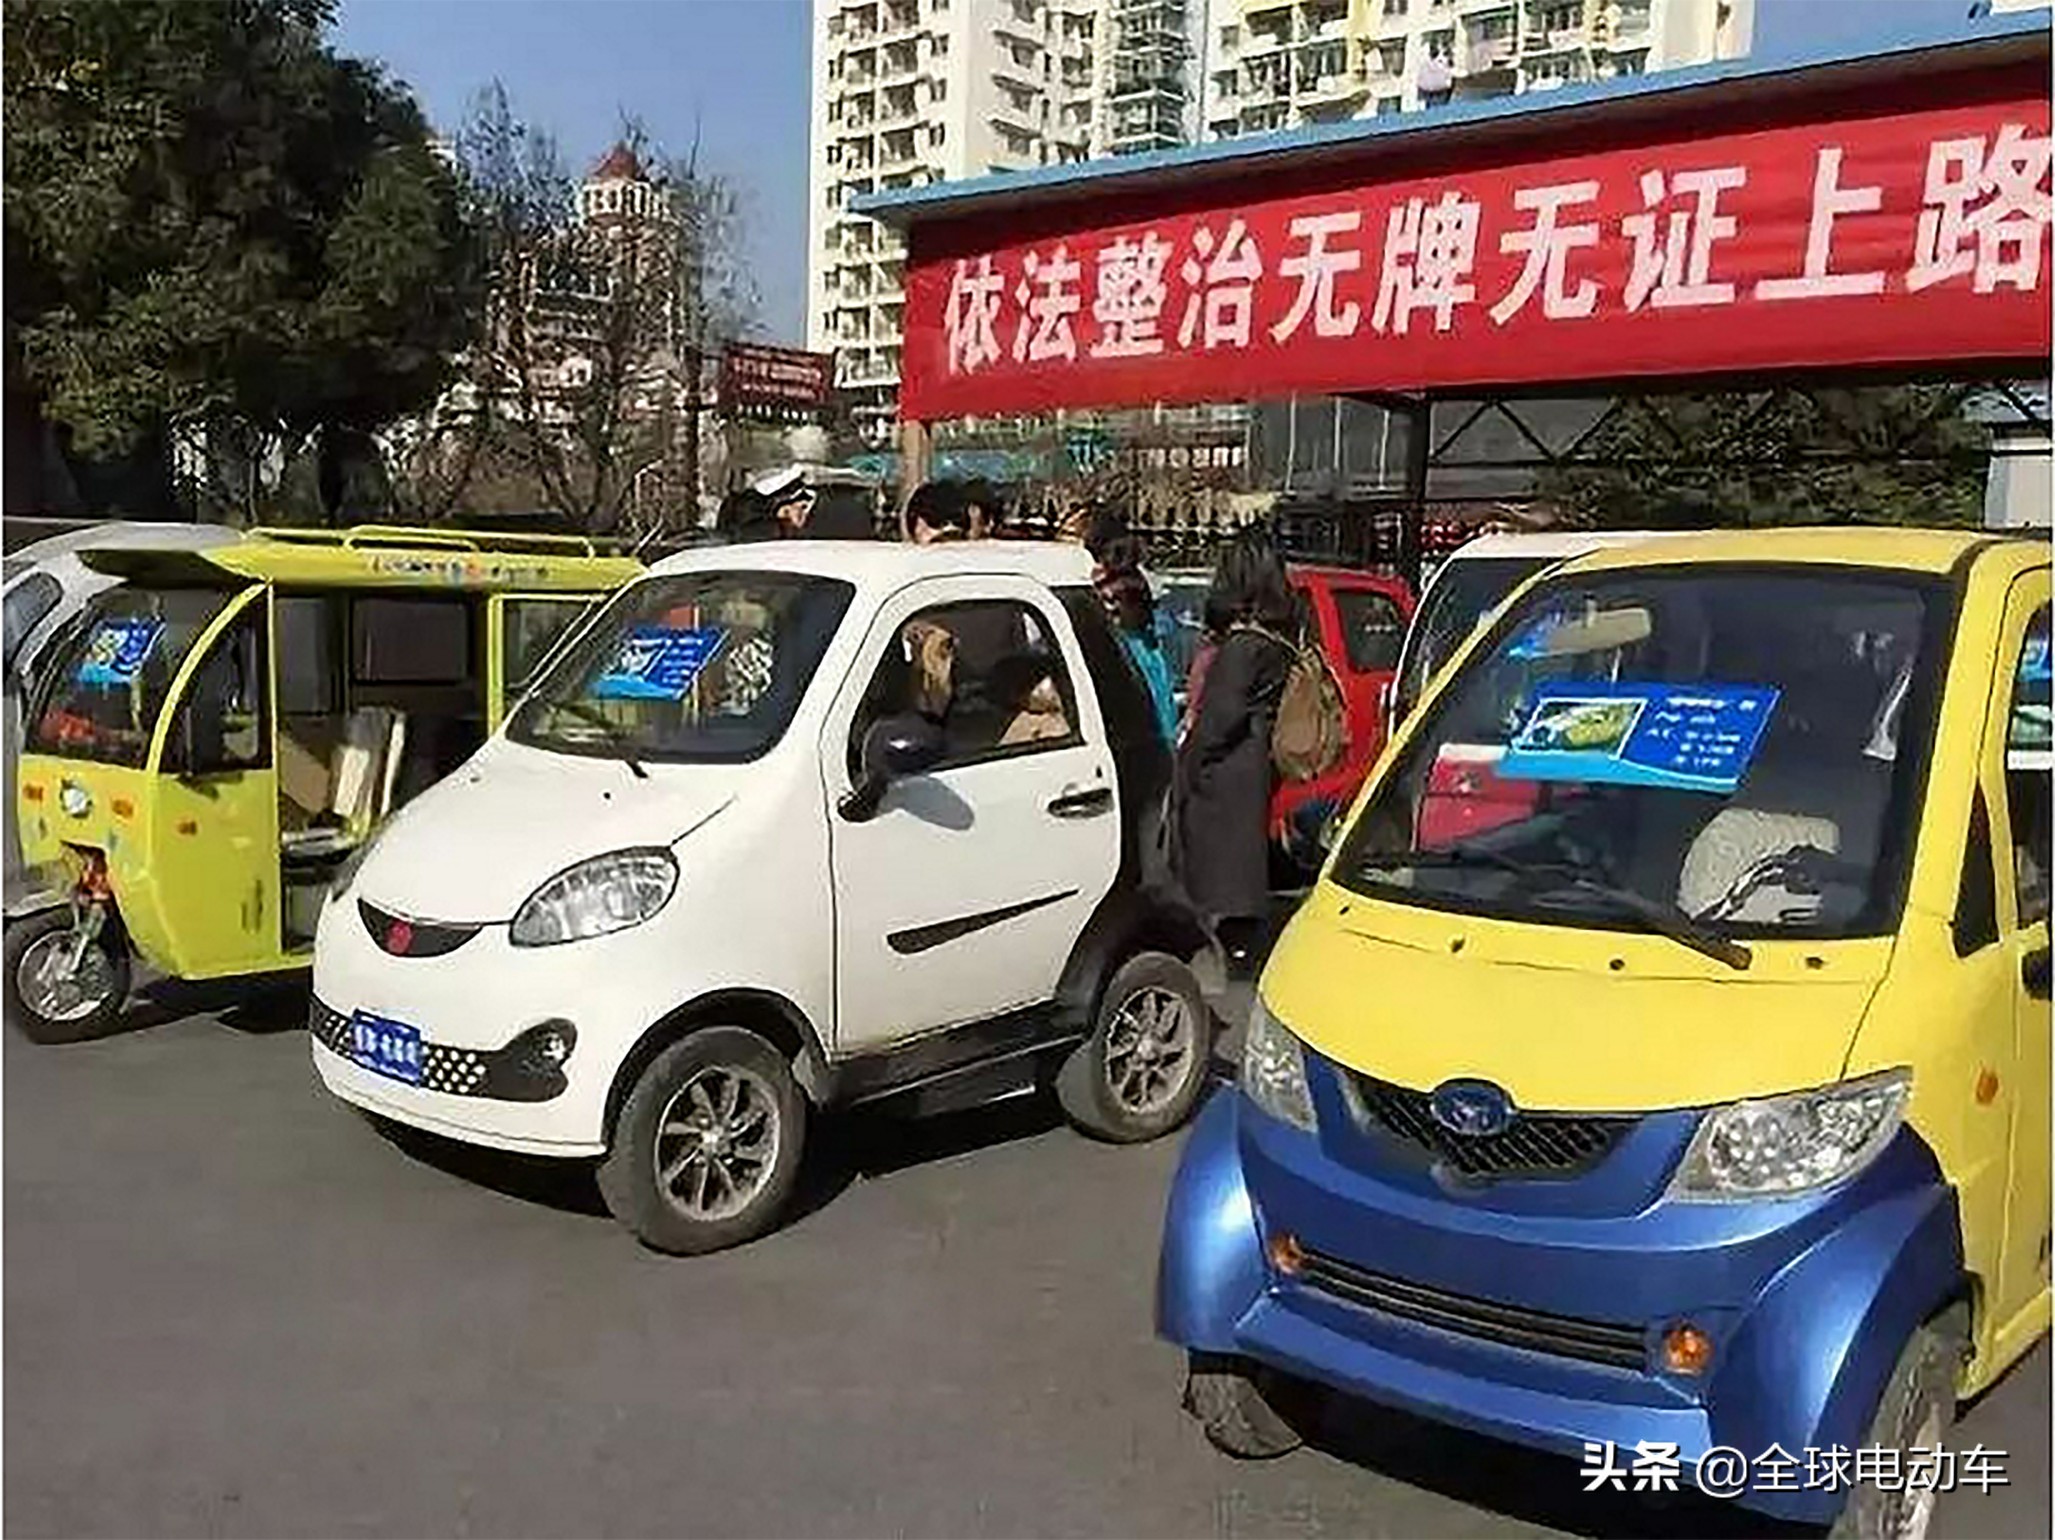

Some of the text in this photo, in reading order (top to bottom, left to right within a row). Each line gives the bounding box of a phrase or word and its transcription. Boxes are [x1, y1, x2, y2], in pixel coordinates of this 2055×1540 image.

[944, 123, 2051, 376] 依法整治无牌无证上路
